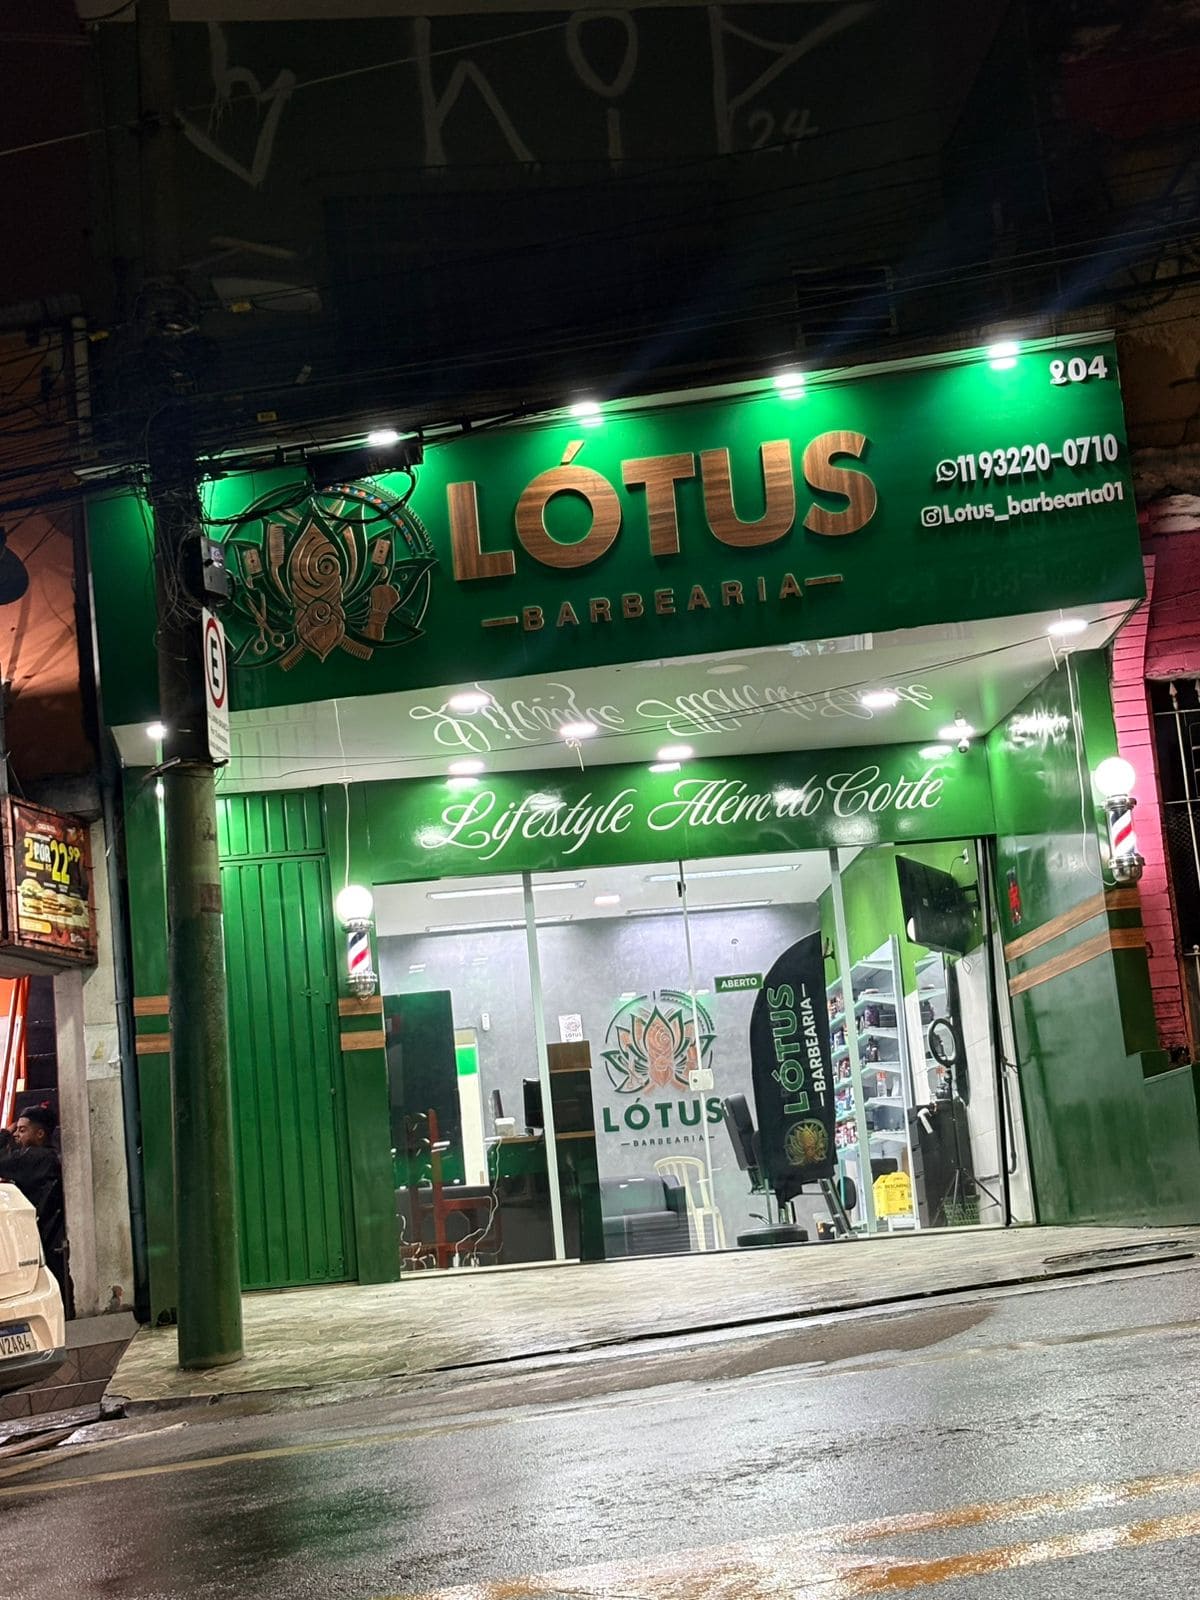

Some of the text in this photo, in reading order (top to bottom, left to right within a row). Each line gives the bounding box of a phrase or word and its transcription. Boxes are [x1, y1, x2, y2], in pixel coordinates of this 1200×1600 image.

[747, 108, 819, 156] 24
[446, 430, 877, 581] LÓTUS
[943, 481, 1124, 524] Lotus_barbearia01
[522, 572, 803, 632] BARBEARIA
[421, 765, 944, 860] Lifestyle Além do Corte
[720, 976, 758, 989] ABERTO
[766, 983, 811, 1114] LÓTUS
[800, 997, 826, 1092] BARBEARIA
[602, 1097, 724, 1133] LÓTUS
[633, 1134, 705, 1148] BARBEARIA
